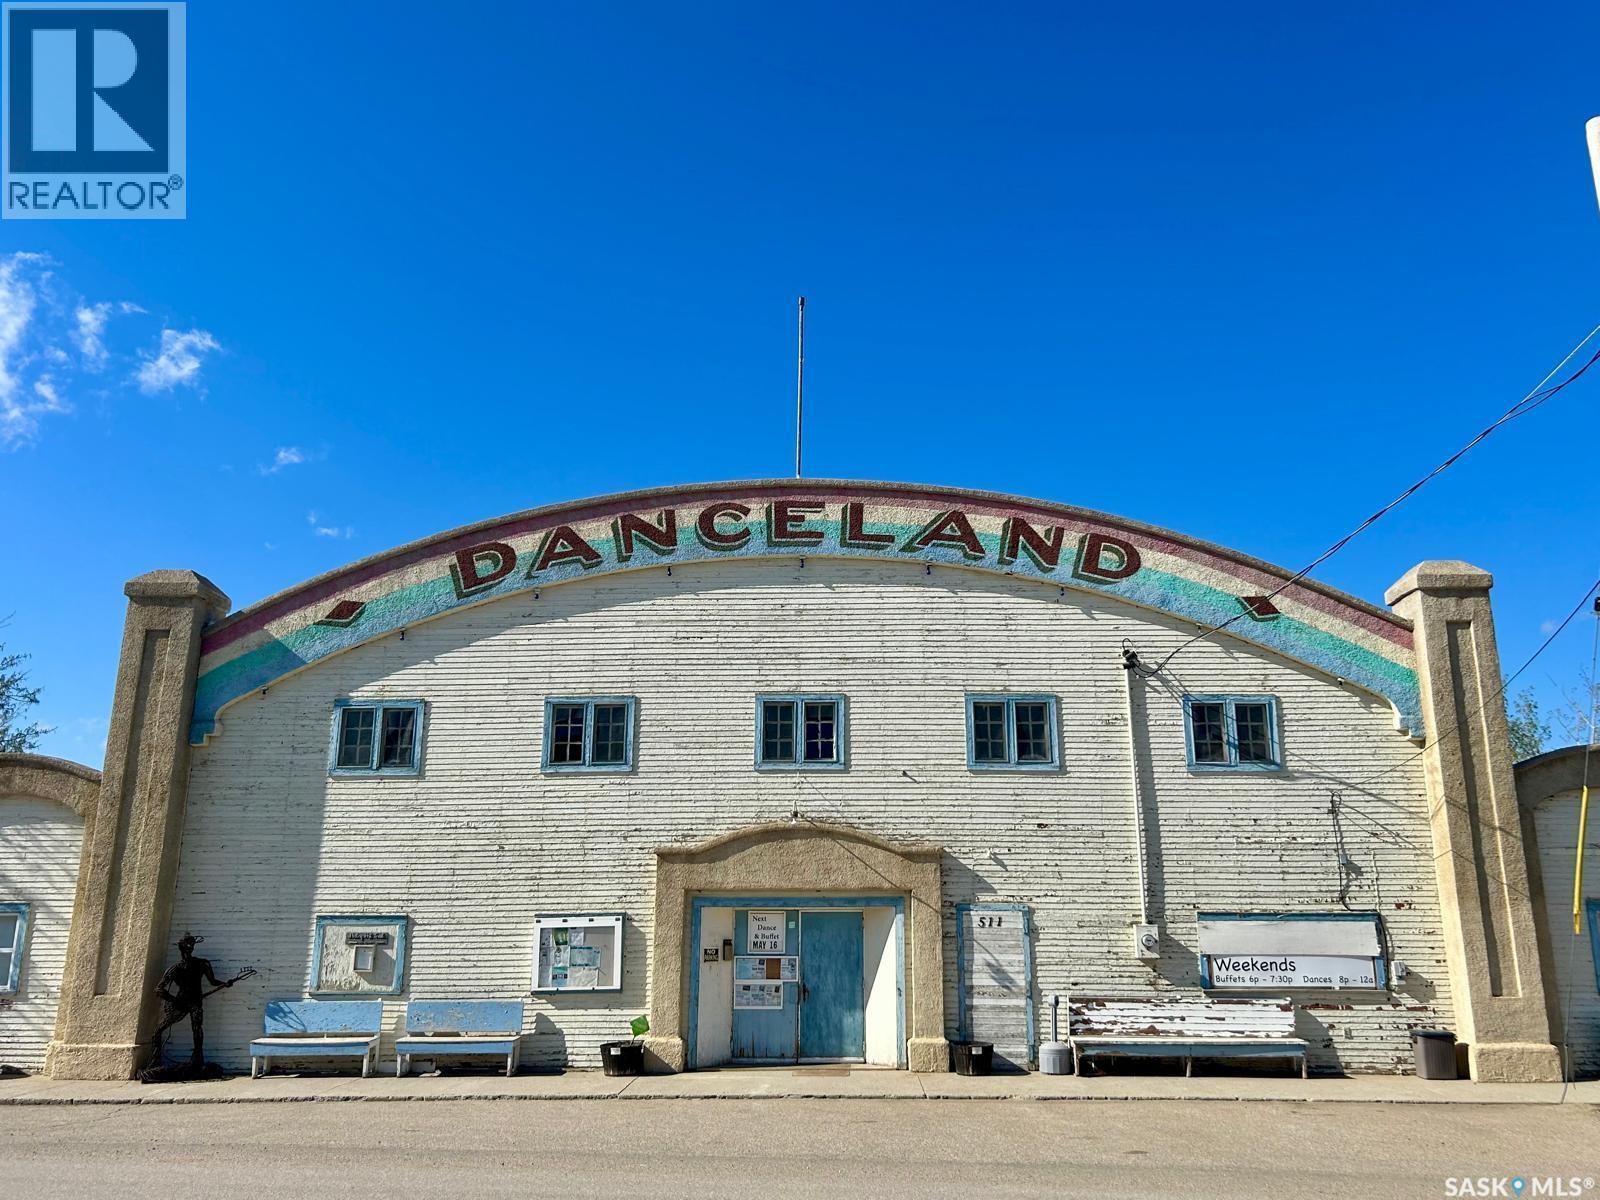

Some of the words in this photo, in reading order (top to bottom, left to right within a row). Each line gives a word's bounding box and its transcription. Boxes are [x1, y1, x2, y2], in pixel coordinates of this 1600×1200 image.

[449, 500, 1141, 601] DANCELAND
[752, 940, 767, 950] MAY
[769, 940, 778, 950] 16
[1213, 957, 1297, 972] Weekends
[1215, 974, 1246, 983] Buffets
[1249, 975, 1259, 985] 6p
[1270, 975, 1293, 985] 7:30p
[1302, 975, 1333, 984] Dances
[1338, 975, 1349, 985] 8p
[1360, 975, 1374, 984] 12a
